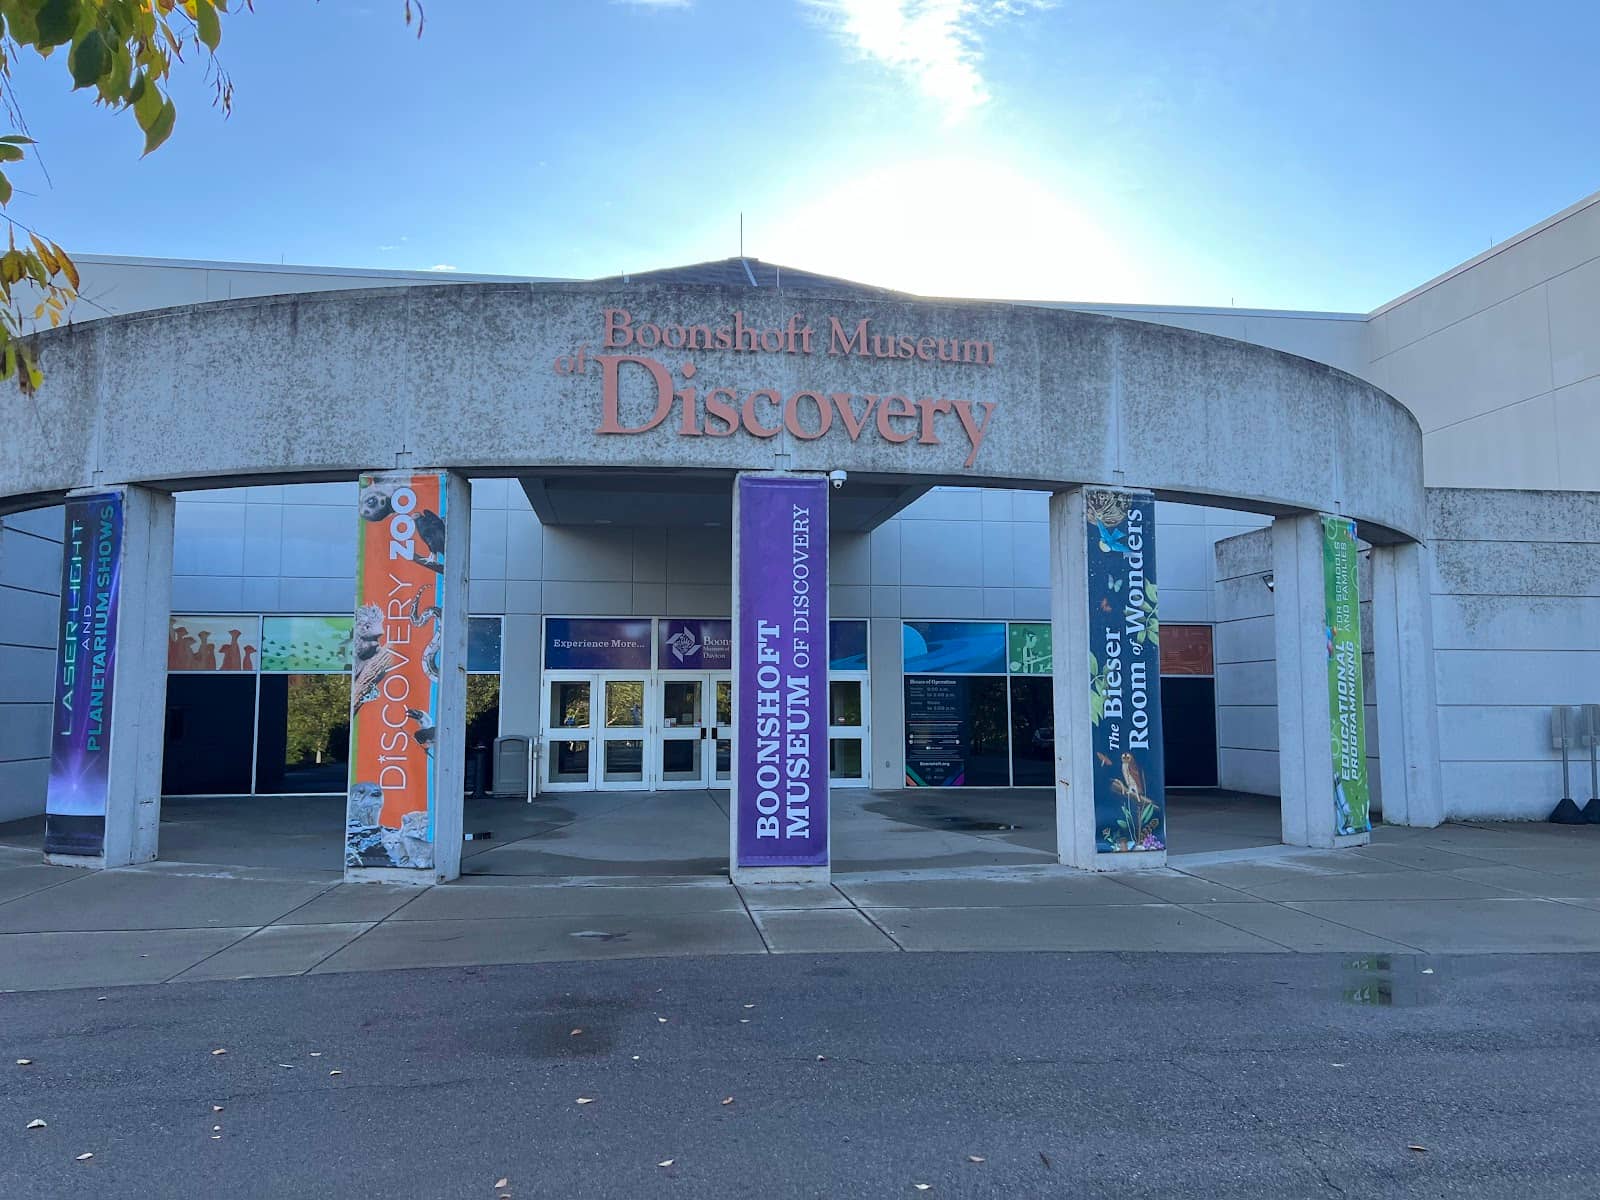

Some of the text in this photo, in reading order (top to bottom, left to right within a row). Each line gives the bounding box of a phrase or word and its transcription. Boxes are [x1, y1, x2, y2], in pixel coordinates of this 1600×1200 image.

[603, 308, 995, 366] Boonshoft Museum
[554, 344, 997, 468] of Discovery
[389, 487, 417, 560] ZOO
[61, 520, 84, 735] LASER LIGHT
[81, 604, 92, 651] AND
[86, 504, 115, 752] PLANETARIUM SHOWS
[553, 640, 609, 650] Experience
[1122, 509, 1150, 751] Room of Wonders
[1341, 542, 1351, 632] AND FAMILIES
[756, 619, 782, 840] BOONSHOFT
[786, 503, 811, 840] MUSEUM OF DISCOVERY
[1103, 627, 1123, 751] The Bieser
[1335, 640, 1351, 780] EDUCATIONAL
